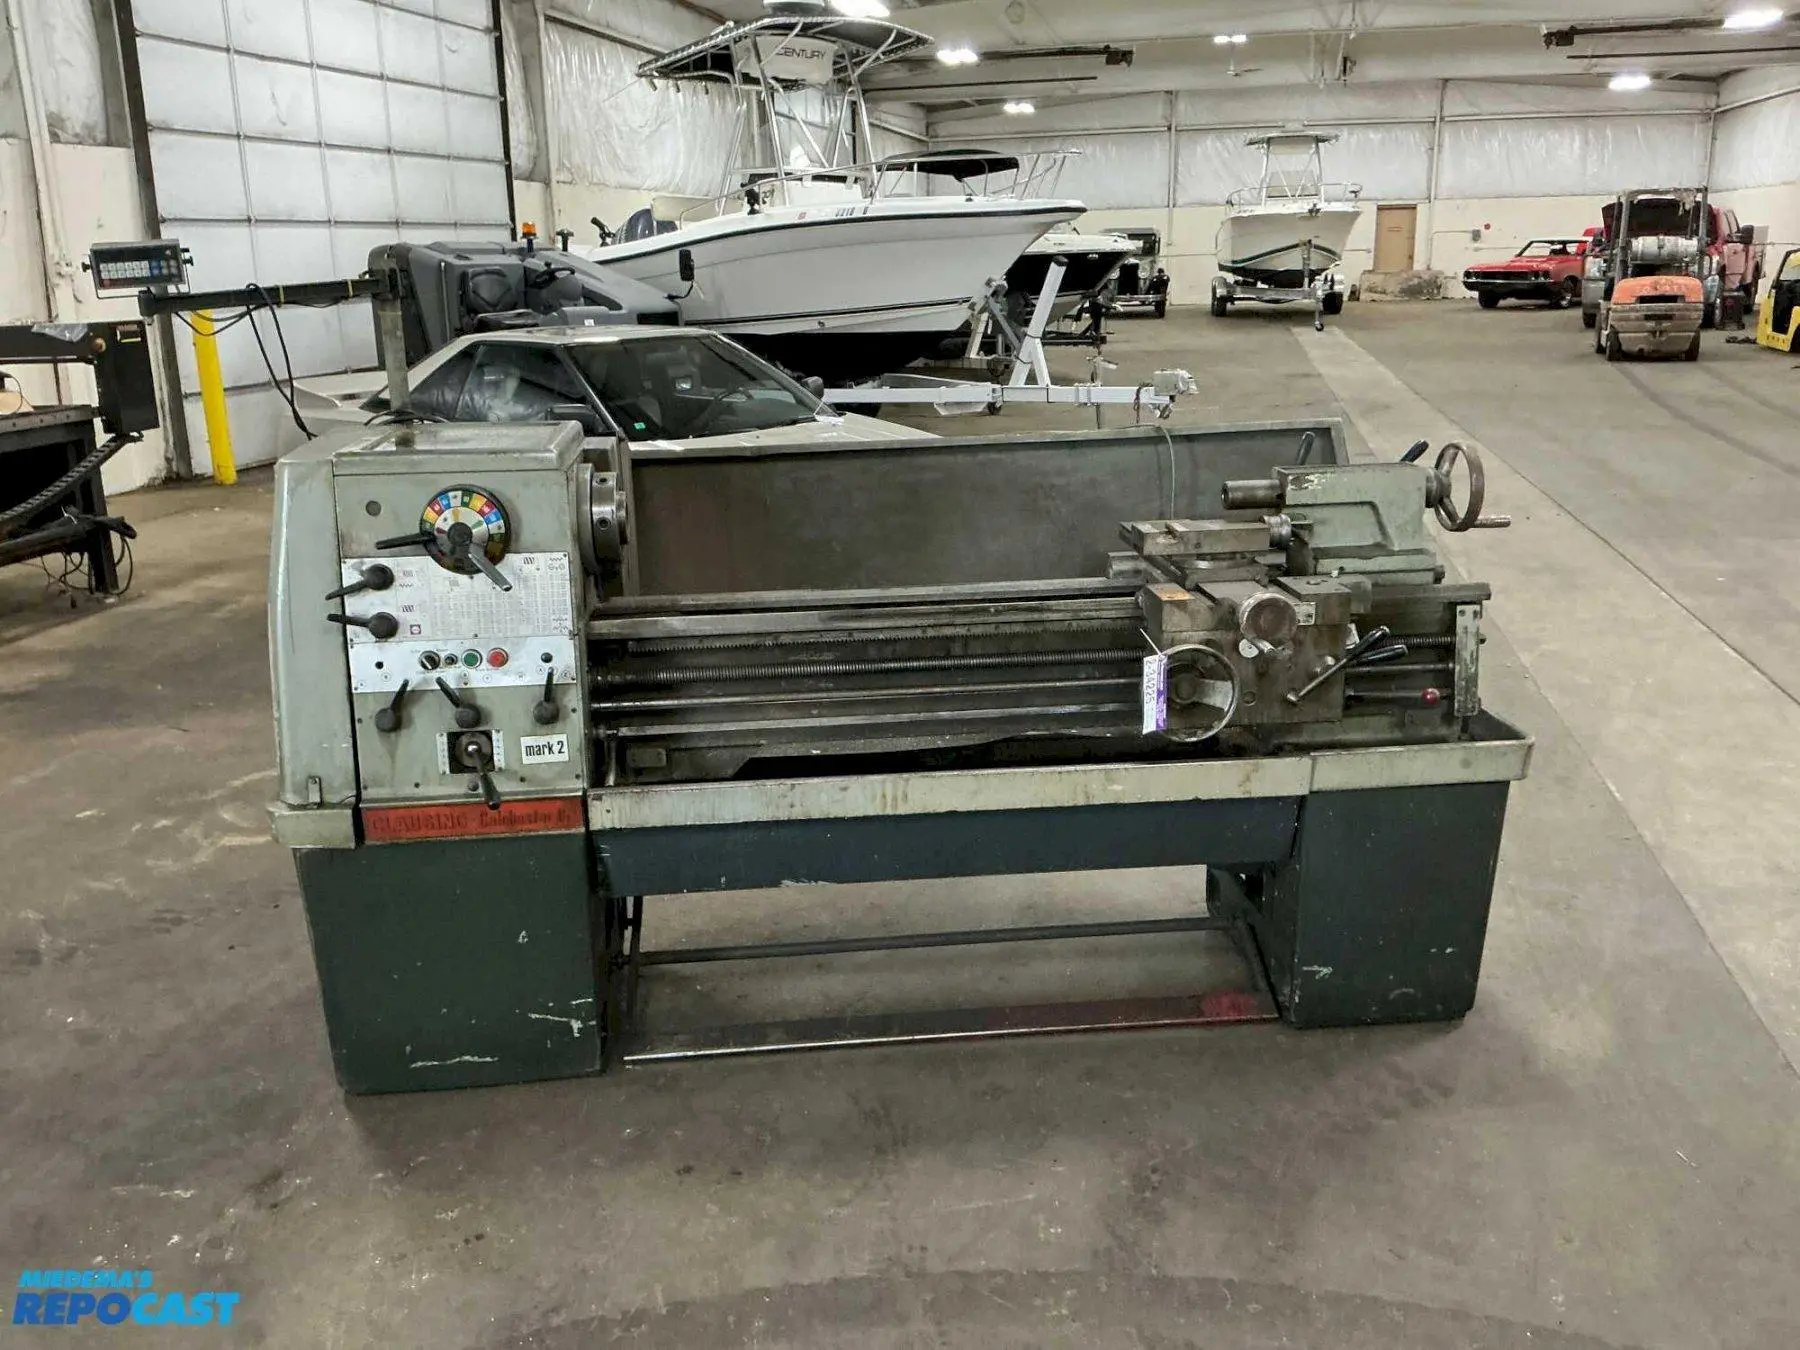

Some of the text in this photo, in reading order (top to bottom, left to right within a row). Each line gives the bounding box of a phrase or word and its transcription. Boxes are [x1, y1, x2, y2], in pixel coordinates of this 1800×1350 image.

[775, 46, 827, 60] CENTURY
[525, 740, 565, 757] mark 2
